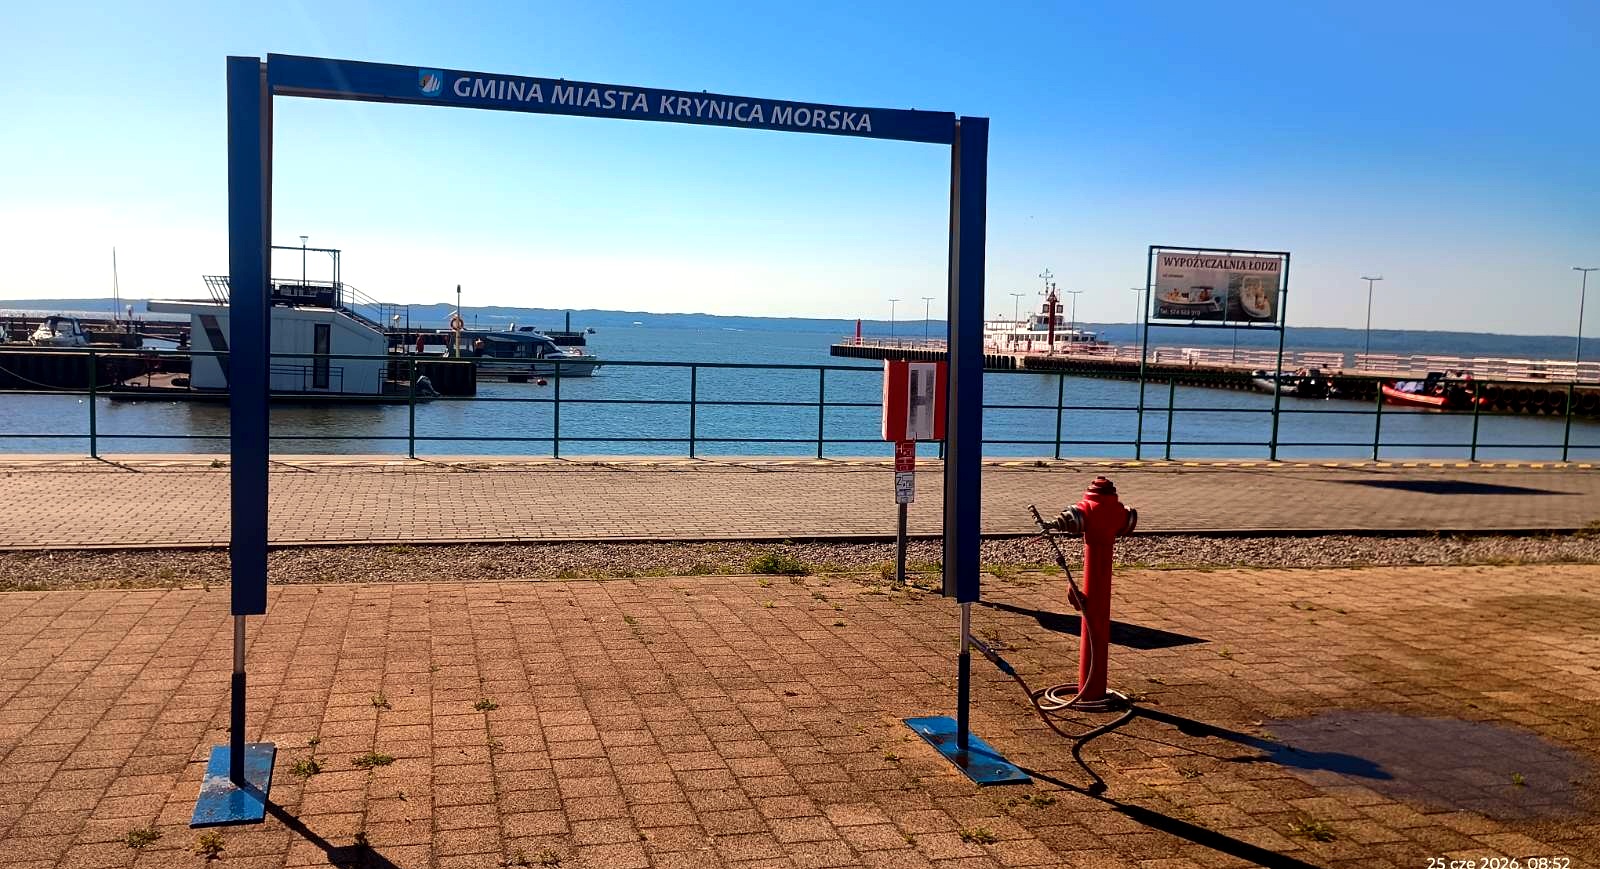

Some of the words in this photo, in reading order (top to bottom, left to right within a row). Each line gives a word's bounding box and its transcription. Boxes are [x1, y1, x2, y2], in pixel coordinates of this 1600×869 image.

[453, 76, 543, 103] GMINA
[551, 85, 649, 112] MIASTA
[659, 95, 764, 123] KRYNICA
[770, 107, 872, 132] MORSKA
[1164, 257, 1247, 270] WYPOŻYCZALNIA
[1248, 260, 1278, 271] ŁODZI
